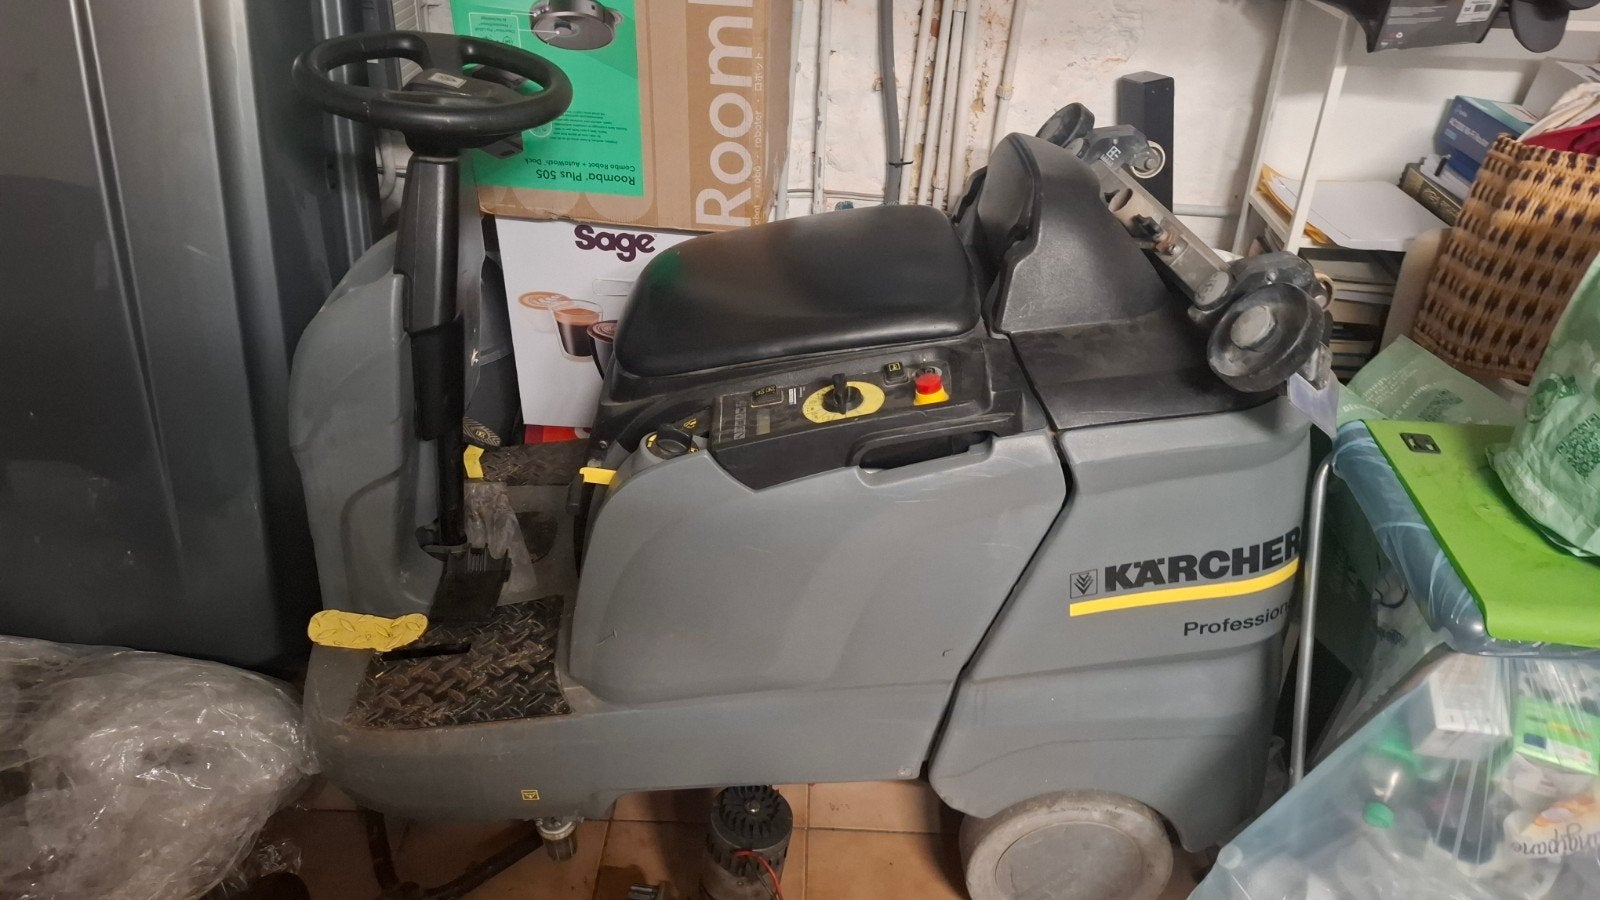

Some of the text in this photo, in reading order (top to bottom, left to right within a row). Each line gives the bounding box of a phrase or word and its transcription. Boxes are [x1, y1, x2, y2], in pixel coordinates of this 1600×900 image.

[754, 51, 763, 91] ロボット
[688, 0, 753, 227] Room
[754, 110, 763, 148] roboter
[524, 157, 542, 166] Dock
[588, 162, 609, 171] Robot
[609, 163, 636, 172] Combo
[535, 169, 557, 180] 505
[559, 170, 582, 182] Plus
[574, 224, 656, 263] Sage
[1104, 526, 1301, 592] KÄRCHER
